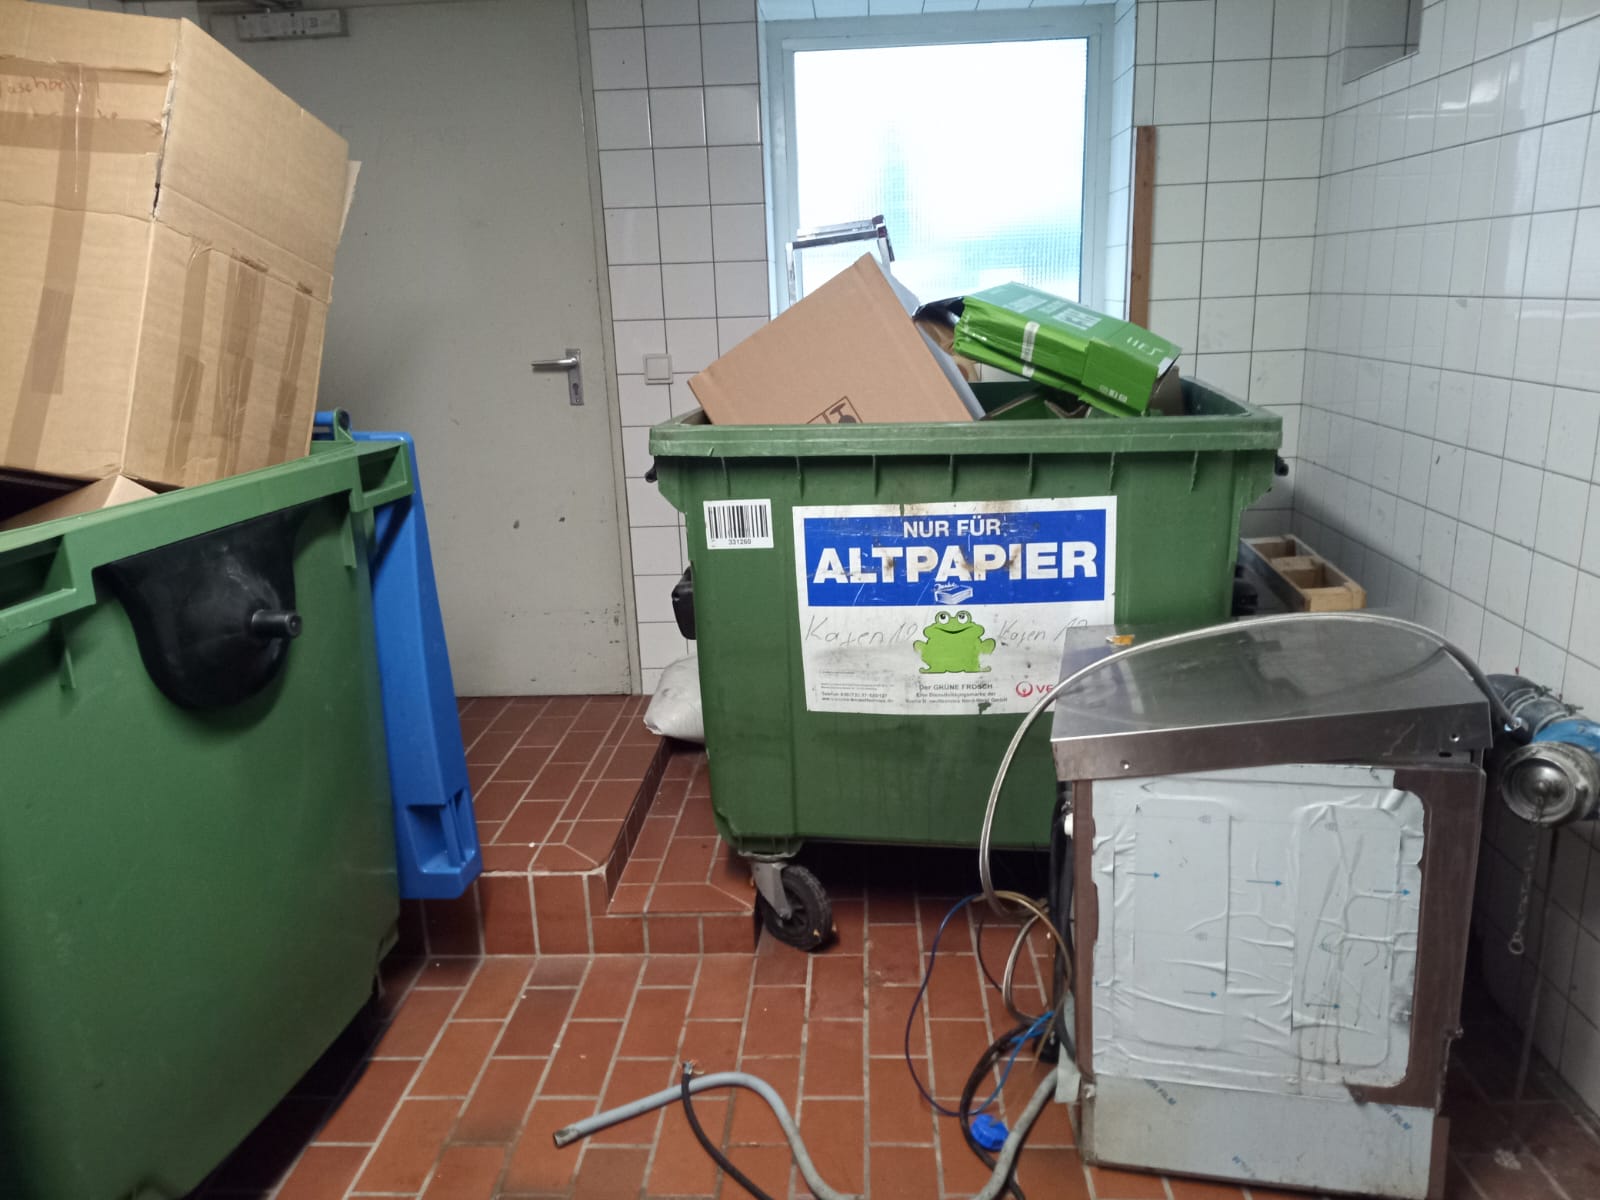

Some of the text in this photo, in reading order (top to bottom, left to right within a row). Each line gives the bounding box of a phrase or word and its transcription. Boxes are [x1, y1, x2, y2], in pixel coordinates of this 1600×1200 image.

[903, 515, 1001, 538] NUR FÜR
[812, 541, 1098, 584] ALTPAPIER
